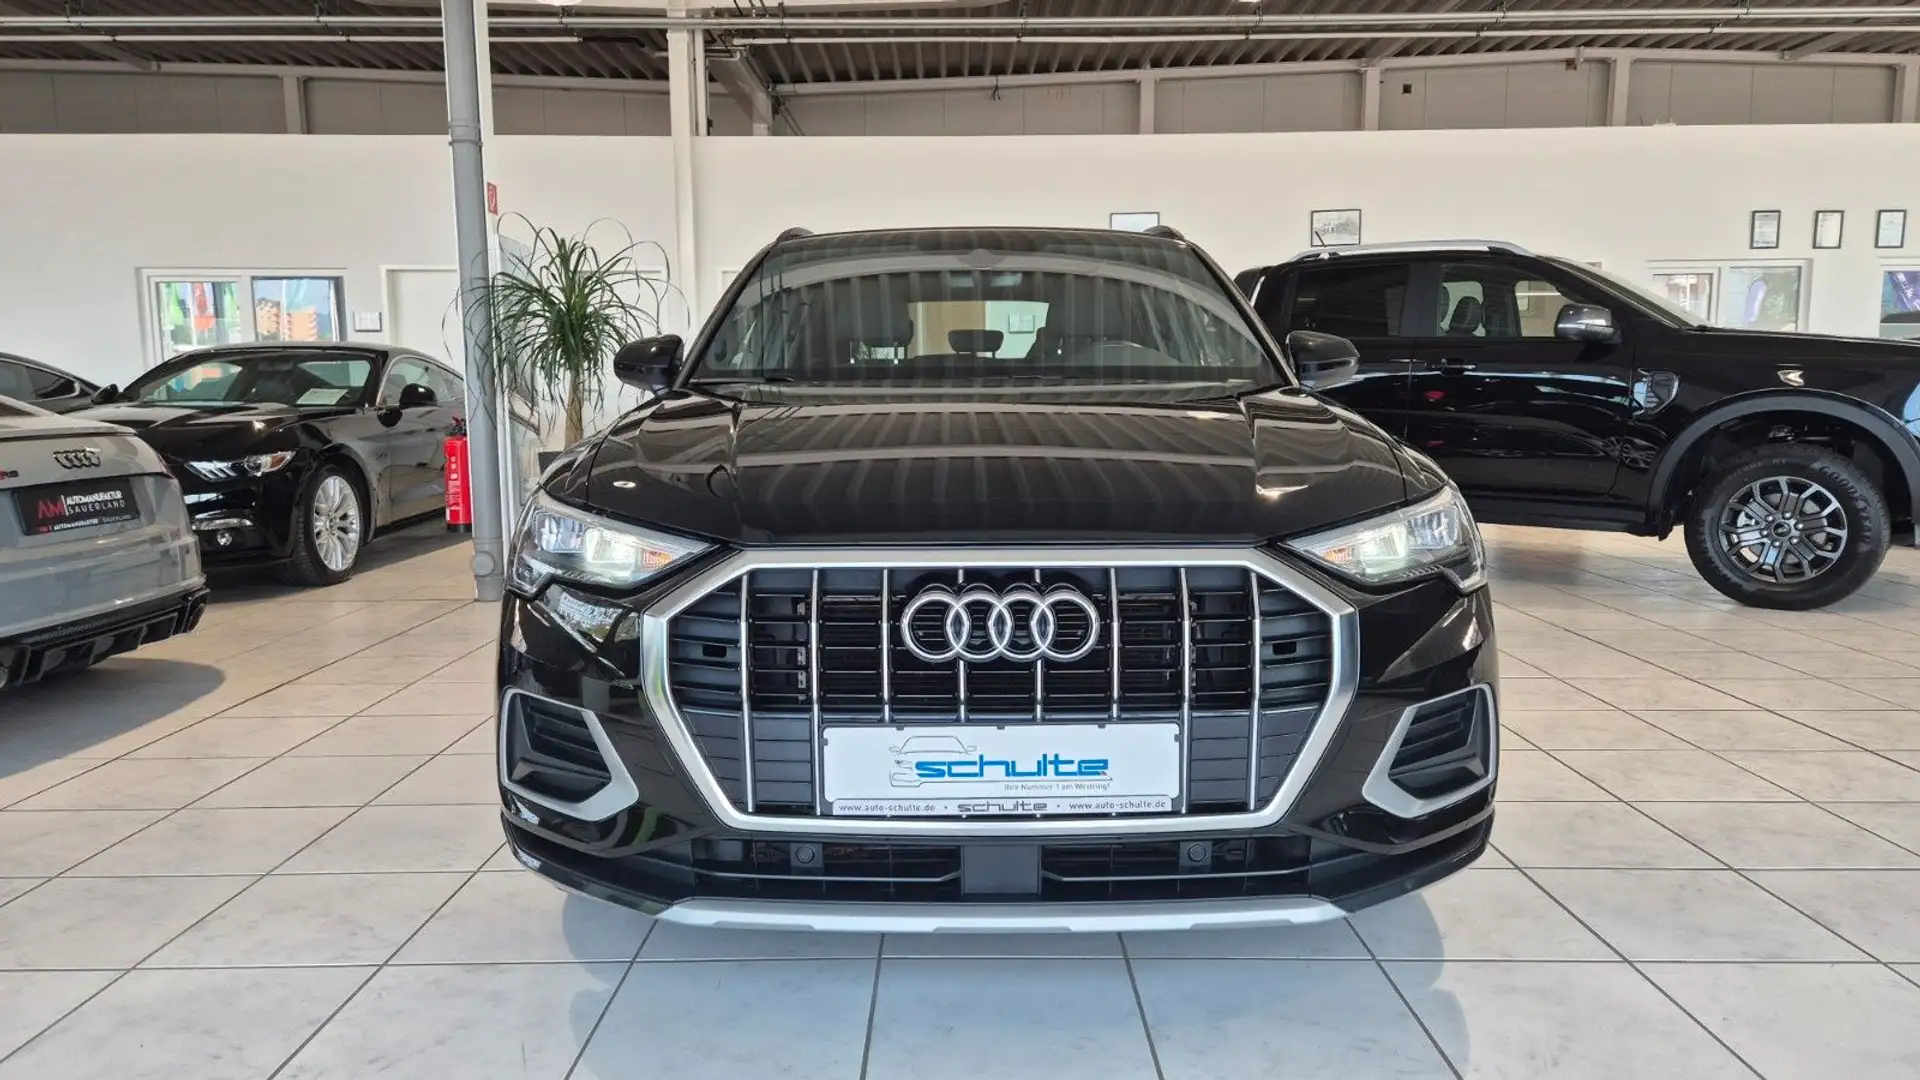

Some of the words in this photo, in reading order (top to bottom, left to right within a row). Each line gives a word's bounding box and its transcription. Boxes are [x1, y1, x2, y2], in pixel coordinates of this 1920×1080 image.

[66, 490, 123, 505] AUTOMANUFAKTUR
[68, 500, 125, 514] SAUERLAND
[915, 753, 1109, 778] schulte
[1021, 783, 1053, 791] Nummer
[839, 803, 936, 812] www.auto-schulte.de
[957, 800, 1048, 813] schulte
[1069, 799, 1166, 810] www.auto-schulte.de
